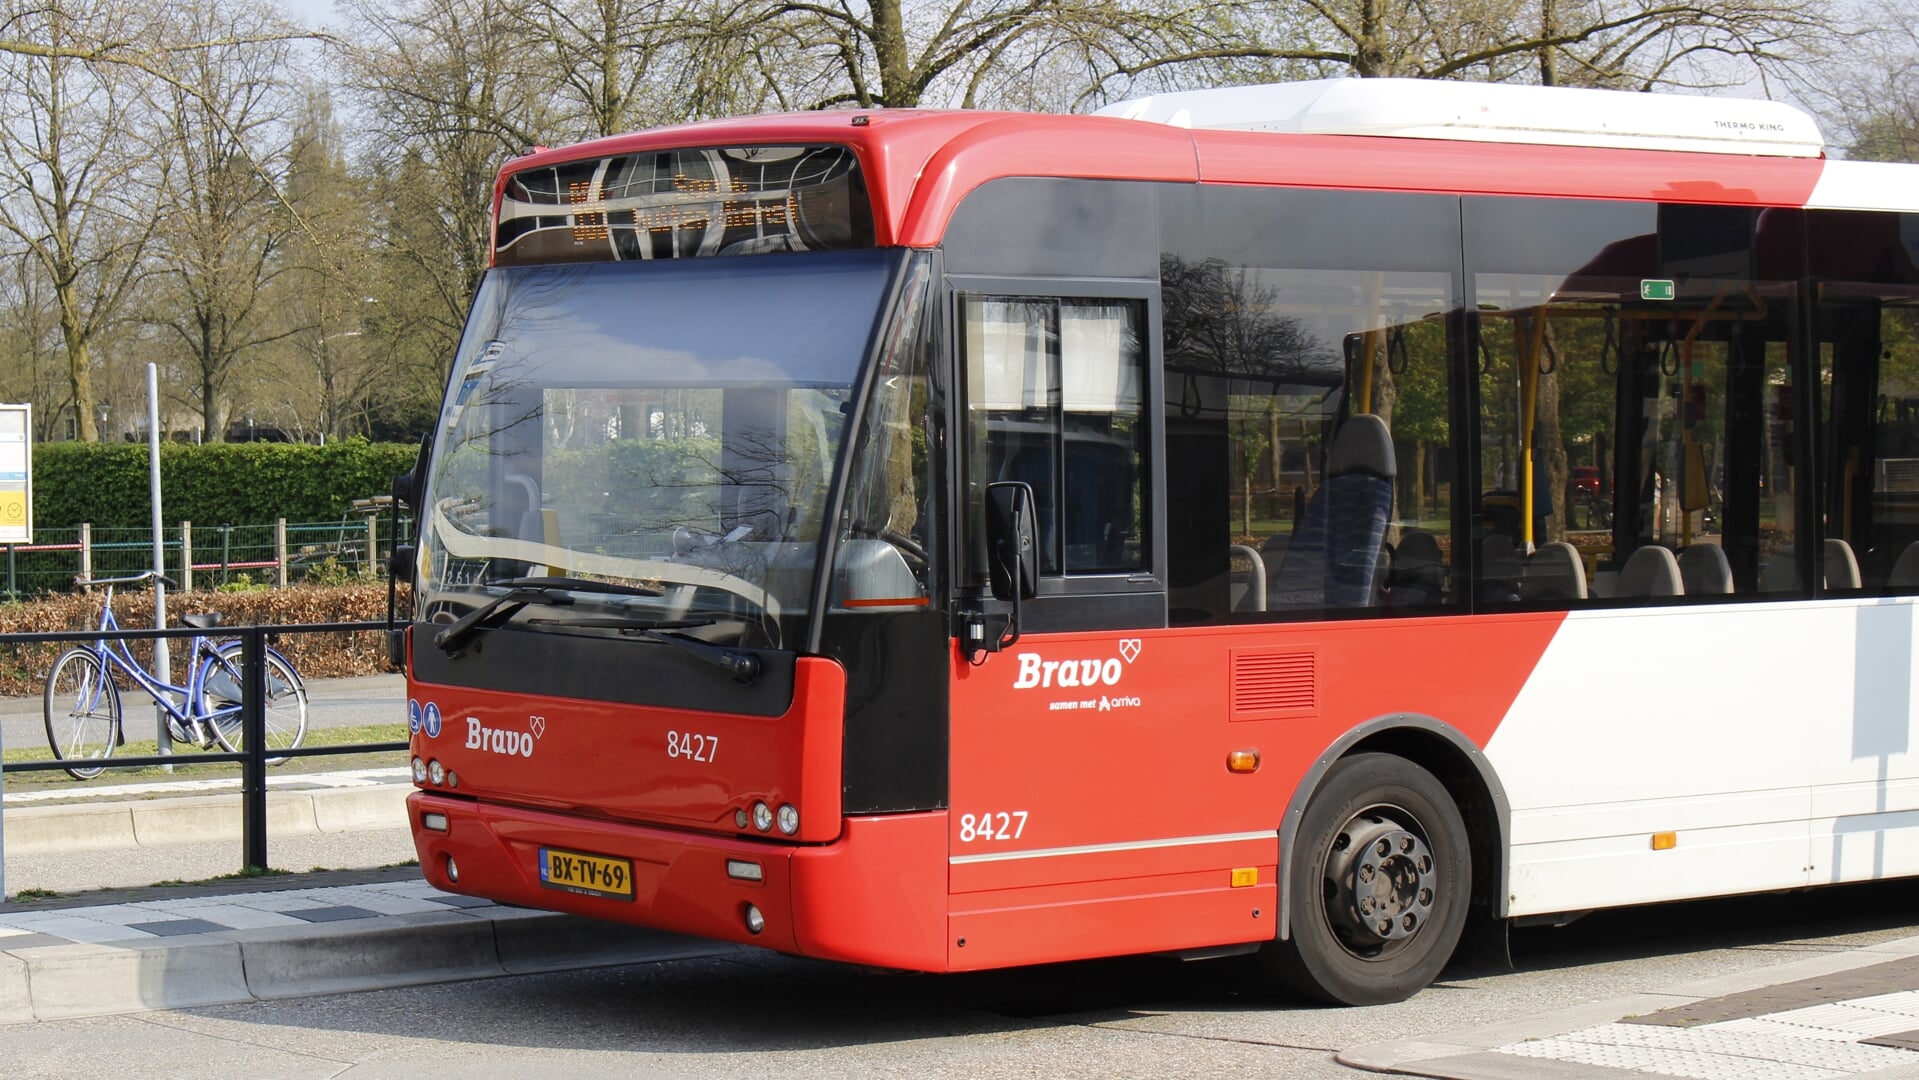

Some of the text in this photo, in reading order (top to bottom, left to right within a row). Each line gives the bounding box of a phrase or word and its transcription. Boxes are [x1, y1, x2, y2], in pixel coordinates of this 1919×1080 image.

[1714, 121, 1784, 131] THERMO KING
[1013, 652, 1122, 689] Bravo
[1049, 695, 1141, 711] samen met arriva
[465, 716, 534, 758] Bravo
[666, 730, 719, 763] 8427
[960, 810, 1029, 842] 8427
[541, 867, 548, 876] NL
[552, 855, 624, 888] BX-TV-69
